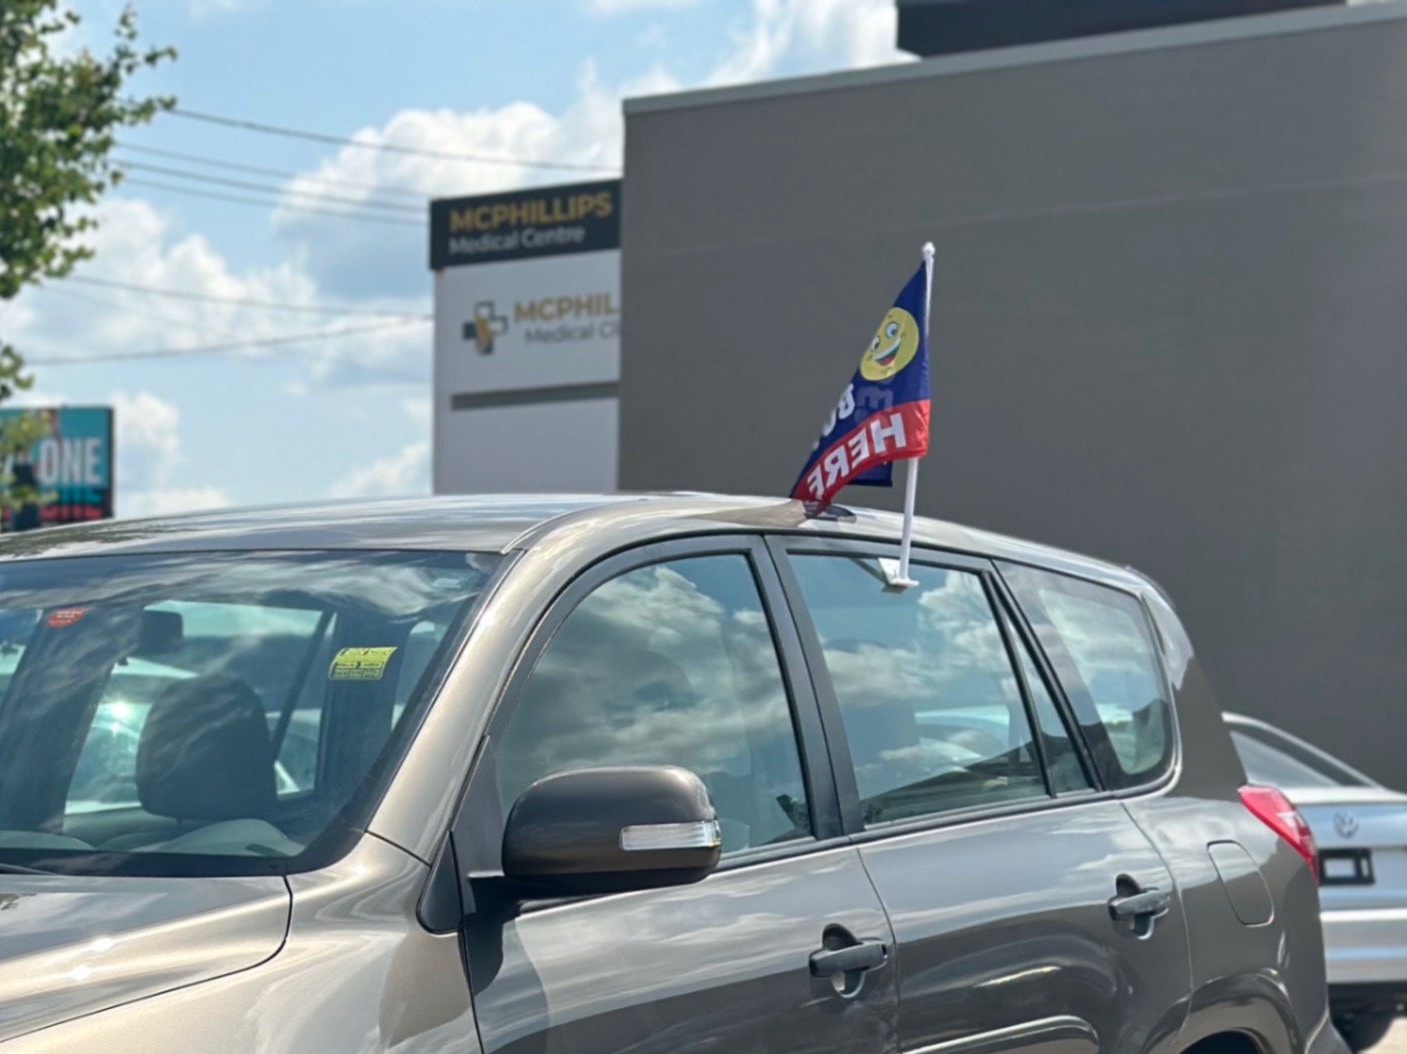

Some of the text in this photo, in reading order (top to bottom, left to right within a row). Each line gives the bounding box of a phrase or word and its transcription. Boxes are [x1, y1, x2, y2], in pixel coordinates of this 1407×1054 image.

[450, 191, 613, 232] MCPHILLIPS
[449, 225, 585, 254] Medical Centre
[524, 322, 595, 345] Medical
